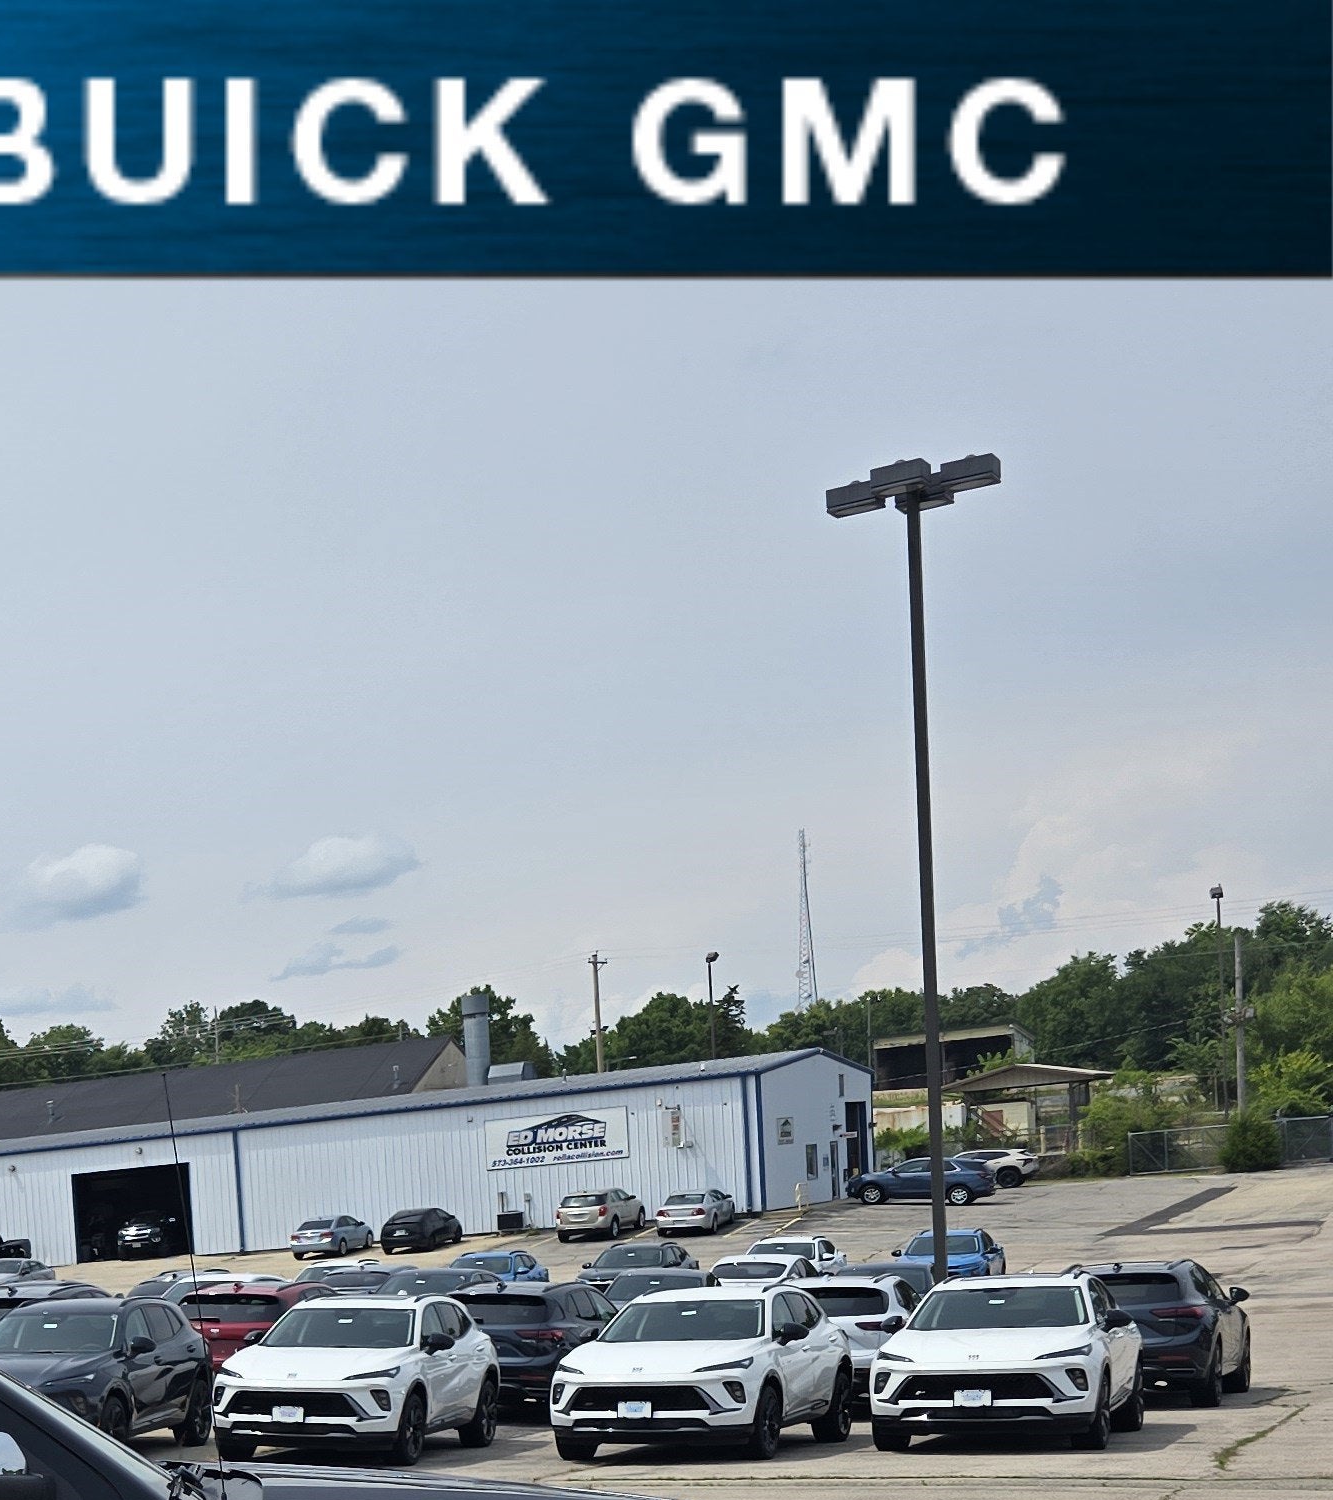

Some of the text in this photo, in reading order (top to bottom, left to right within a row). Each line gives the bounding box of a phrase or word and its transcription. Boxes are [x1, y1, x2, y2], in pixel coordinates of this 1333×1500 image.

[508, 1122, 606, 1147] ED MORSE
[506, 1140, 607, 1156] COLLISION CENTER
